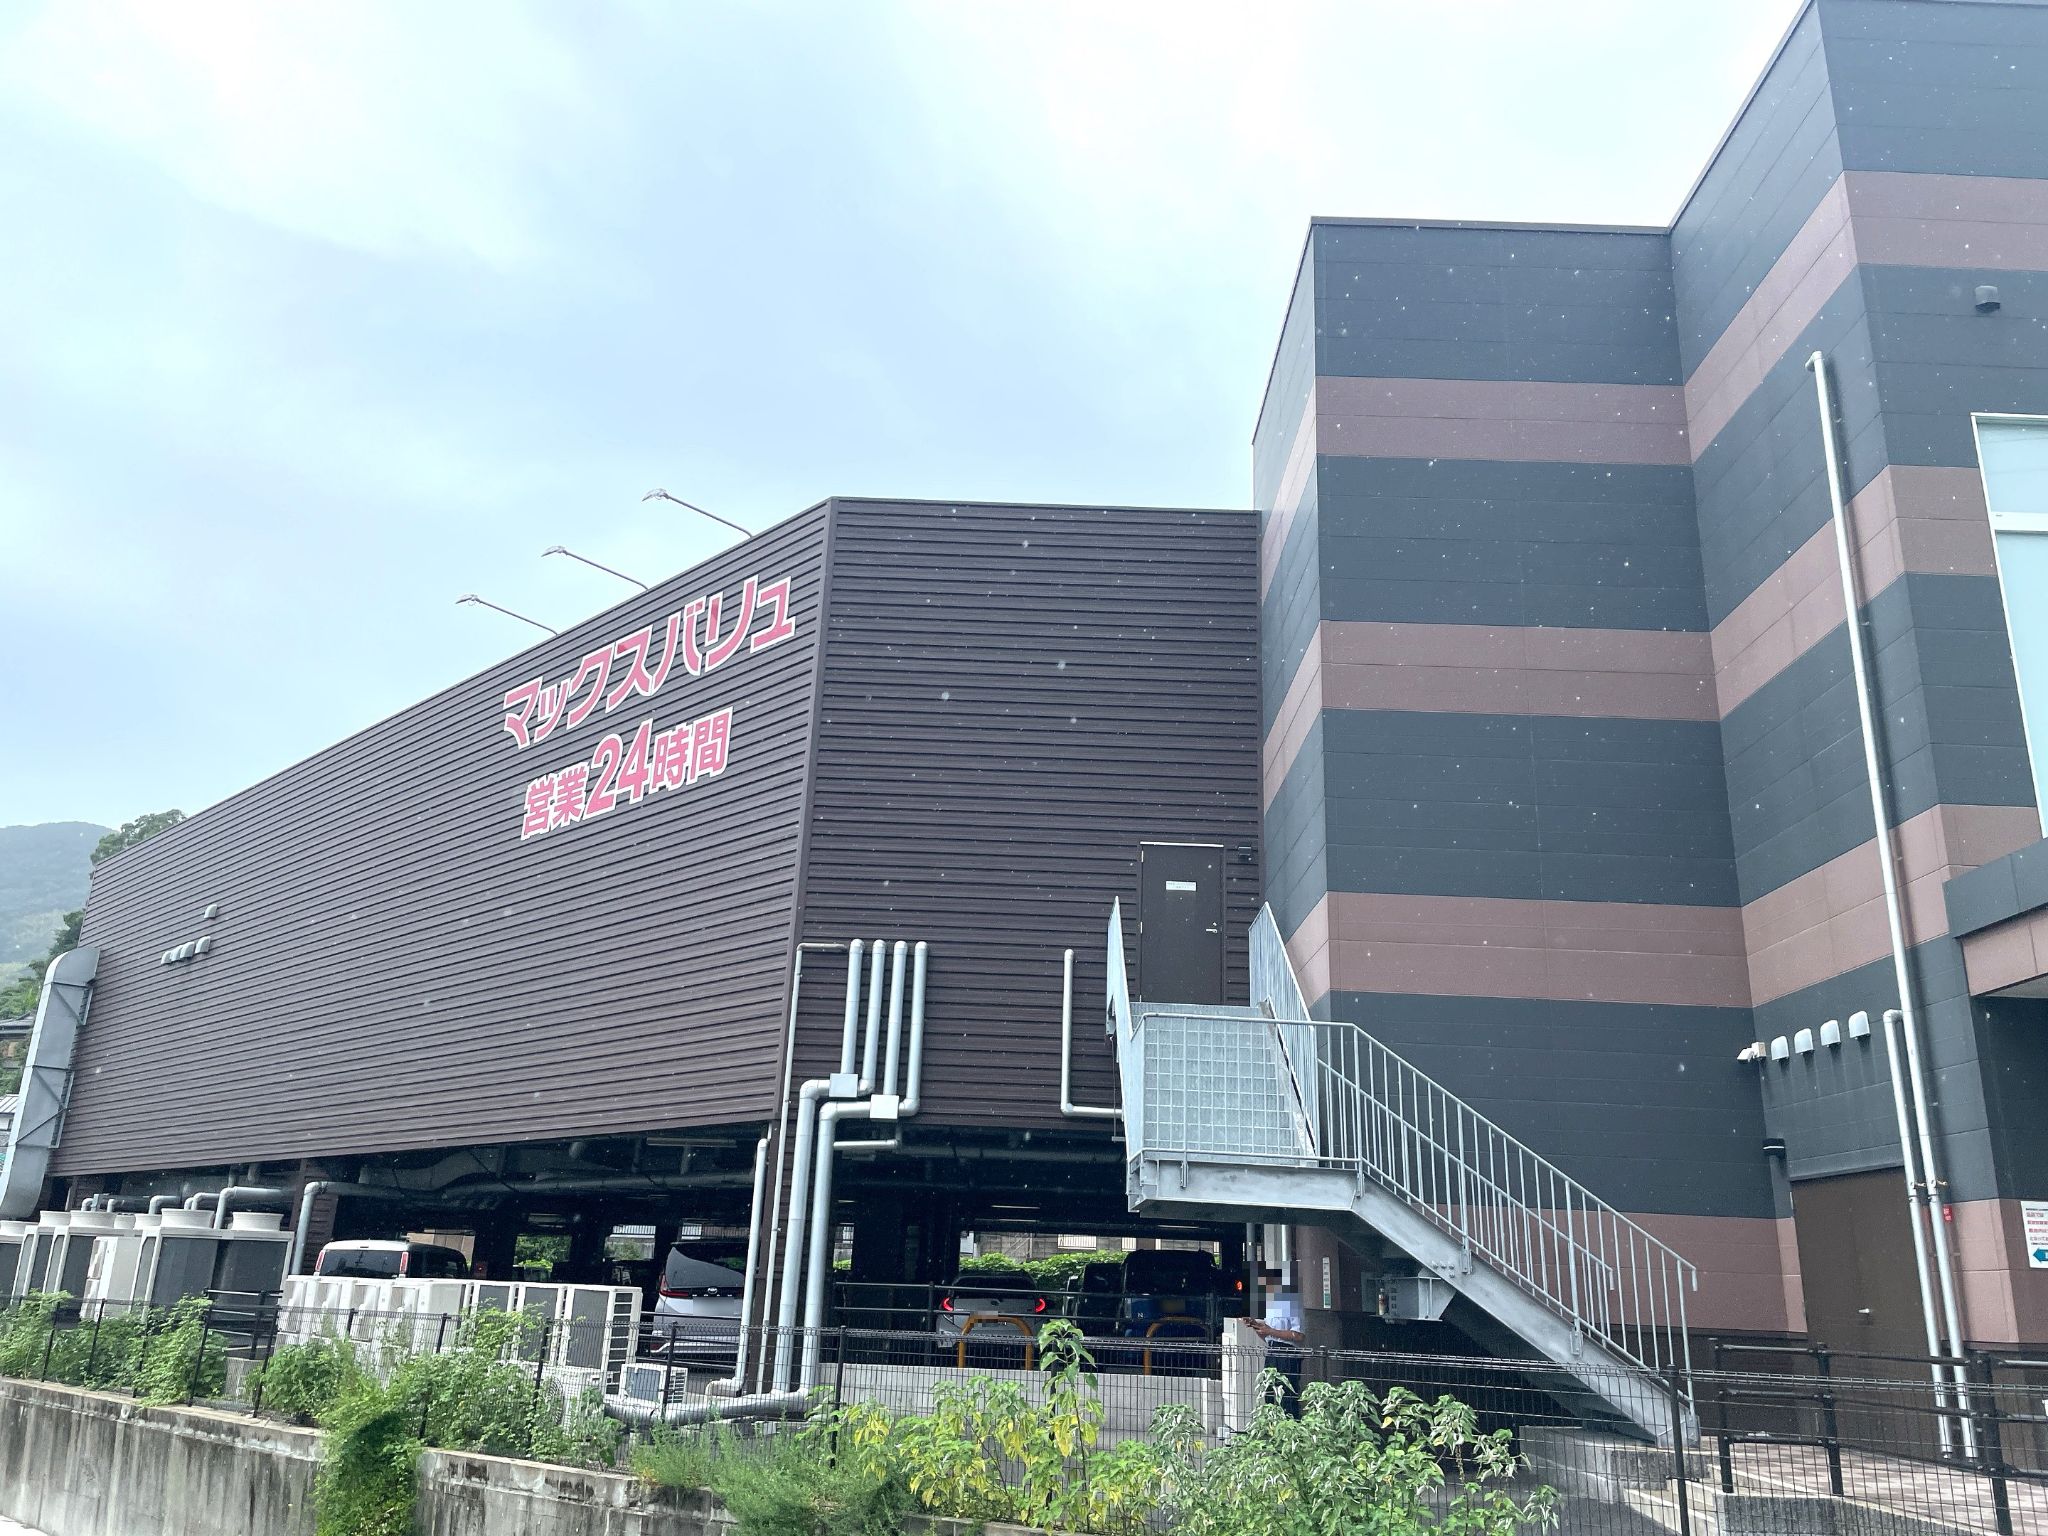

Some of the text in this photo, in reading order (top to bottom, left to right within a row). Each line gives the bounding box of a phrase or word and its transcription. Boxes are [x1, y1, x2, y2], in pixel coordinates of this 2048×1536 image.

[503, 574, 796, 749] マックスバリュ
[521, 706, 733, 840] 営業24時間
